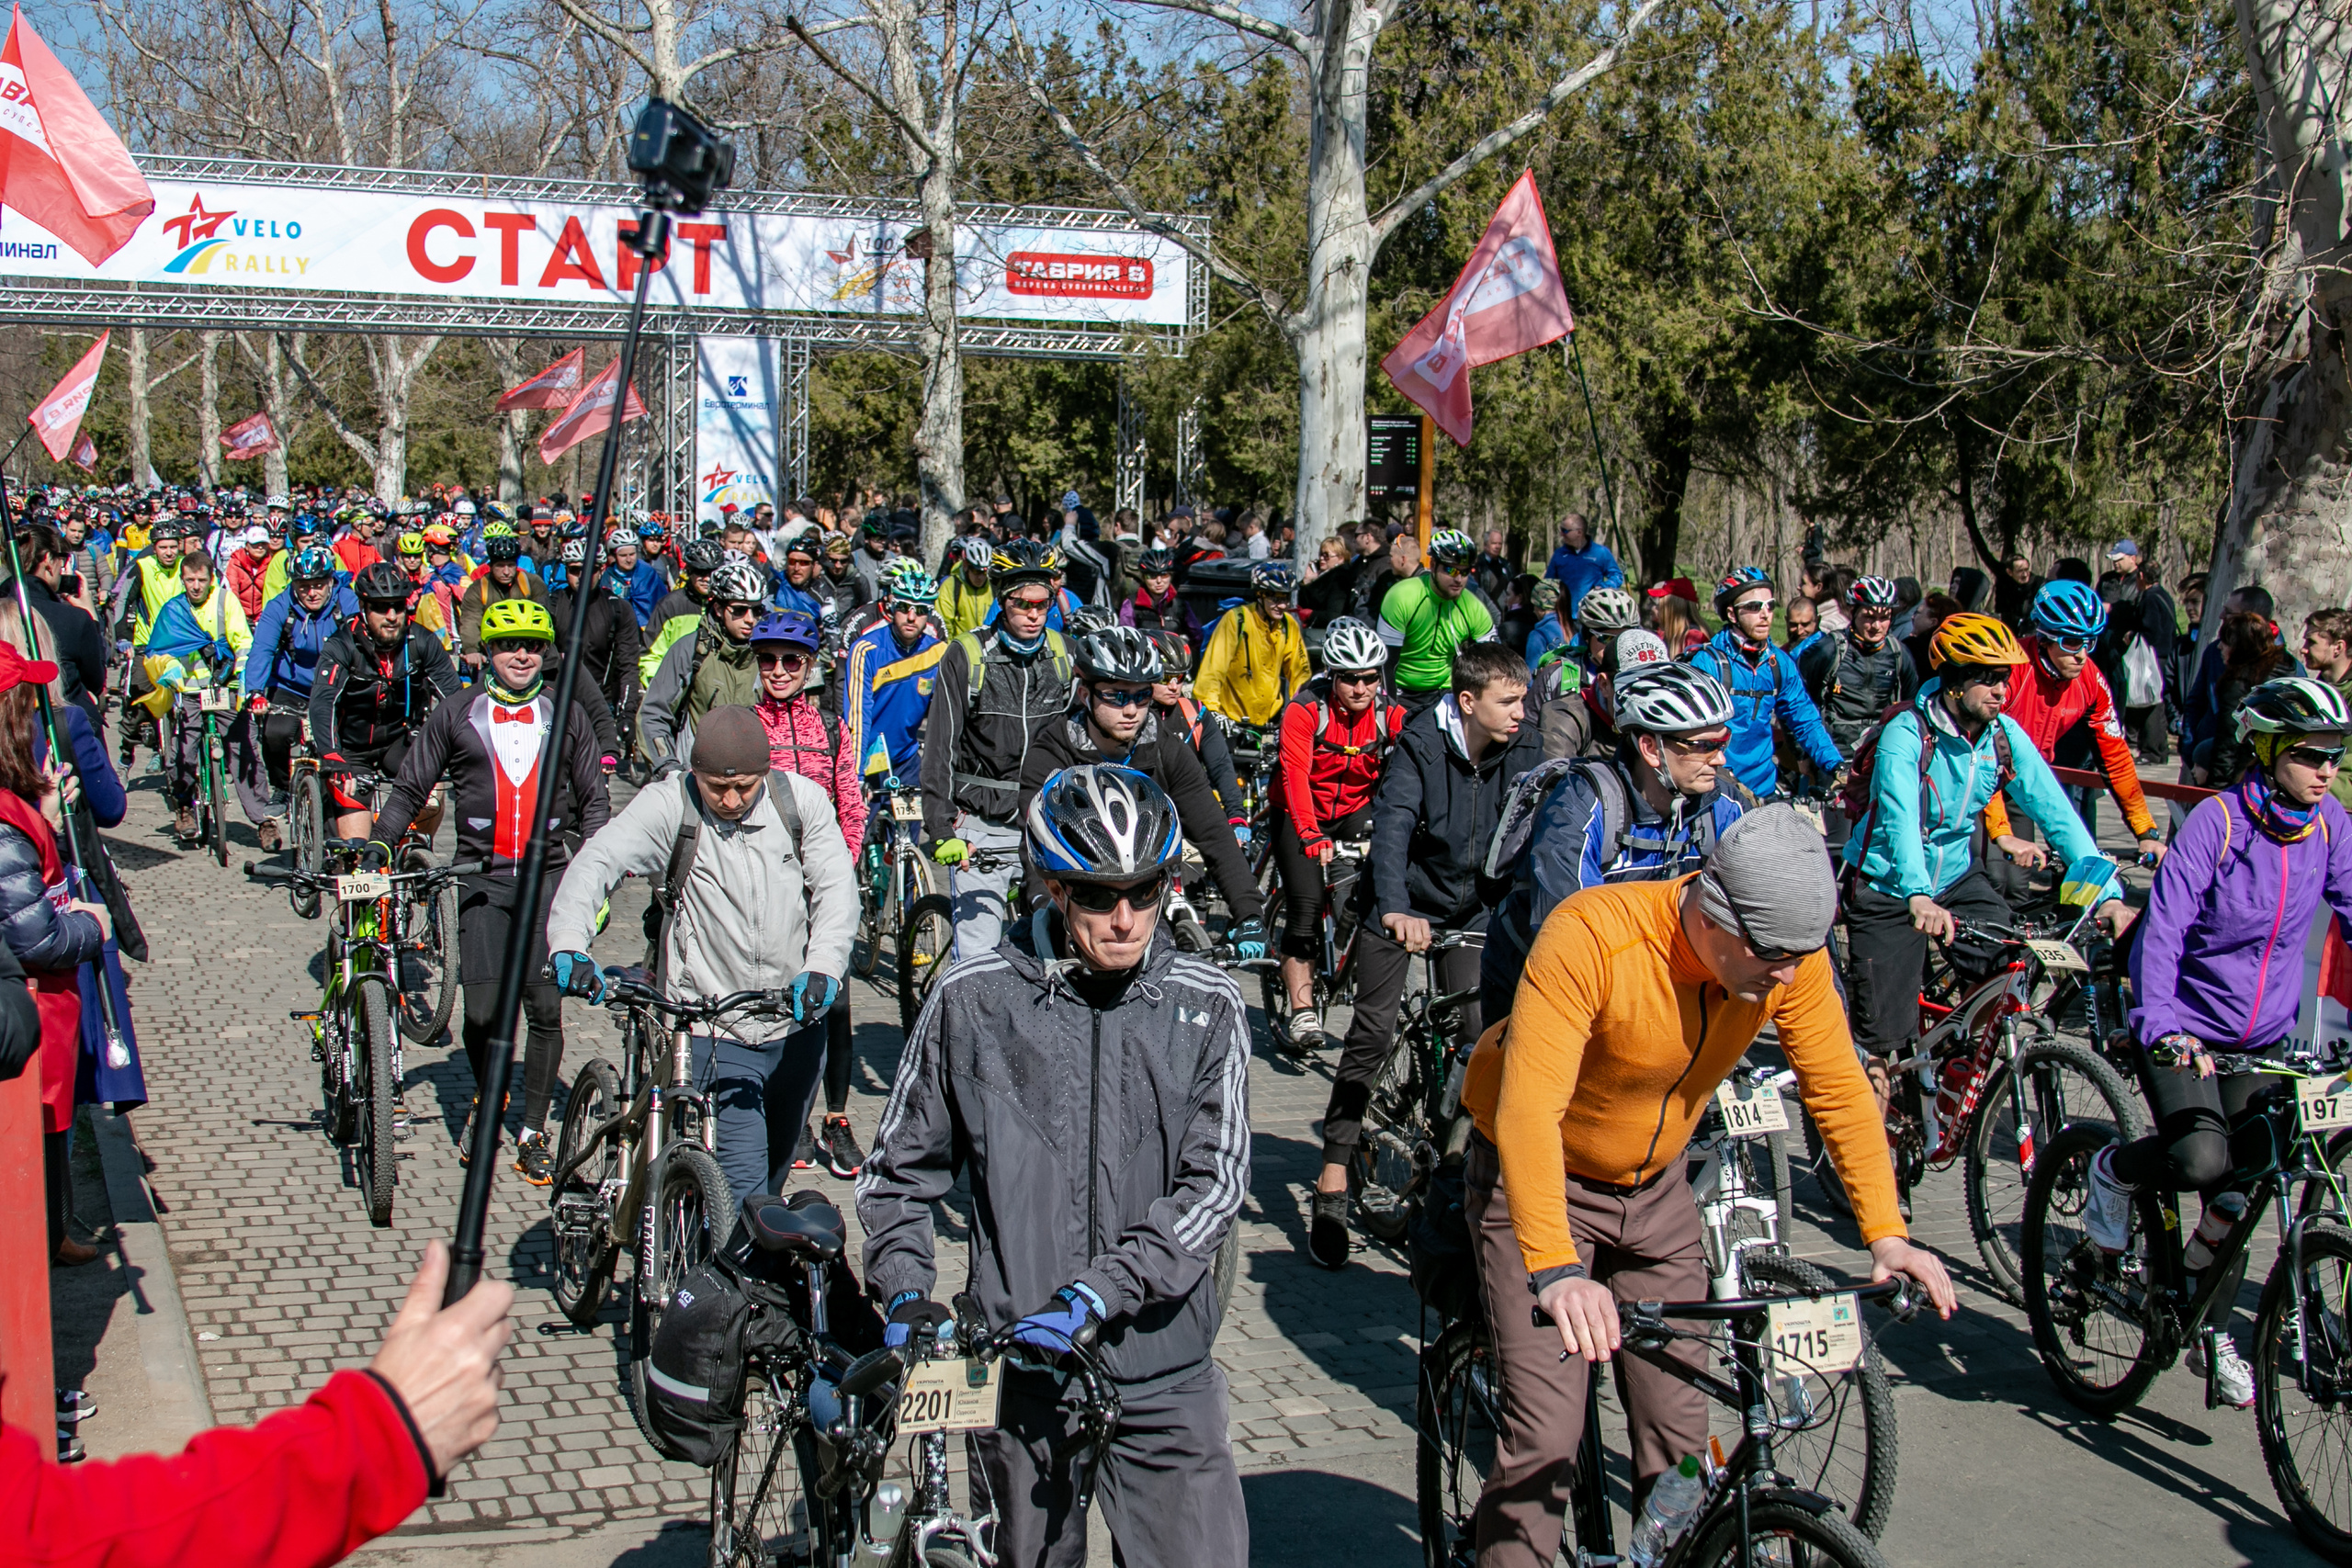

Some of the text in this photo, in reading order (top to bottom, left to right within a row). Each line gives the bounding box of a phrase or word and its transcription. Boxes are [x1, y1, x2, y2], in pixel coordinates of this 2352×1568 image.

[232, 219, 301, 239] VELO
[407, 209, 727, 294] СТАРТ
[864, 237, 894, 251] 100
[226, 254, 310, 275] RALLY
[1014, 261, 1120, 281] ТАВРИЯ
[705, 399, 770, 411] Евротерминал
[736, 474, 769, 484] VELO
[732, 491, 774, 502] RALLY
[1638, 649, 1657, 662] 85
[342, 883, 370, 895] 1700
[1724, 1102, 1761, 1128] 1814
[1776, 1329, 1828, 1361] 1715
[900, 1389, 953, 1424] 2201
